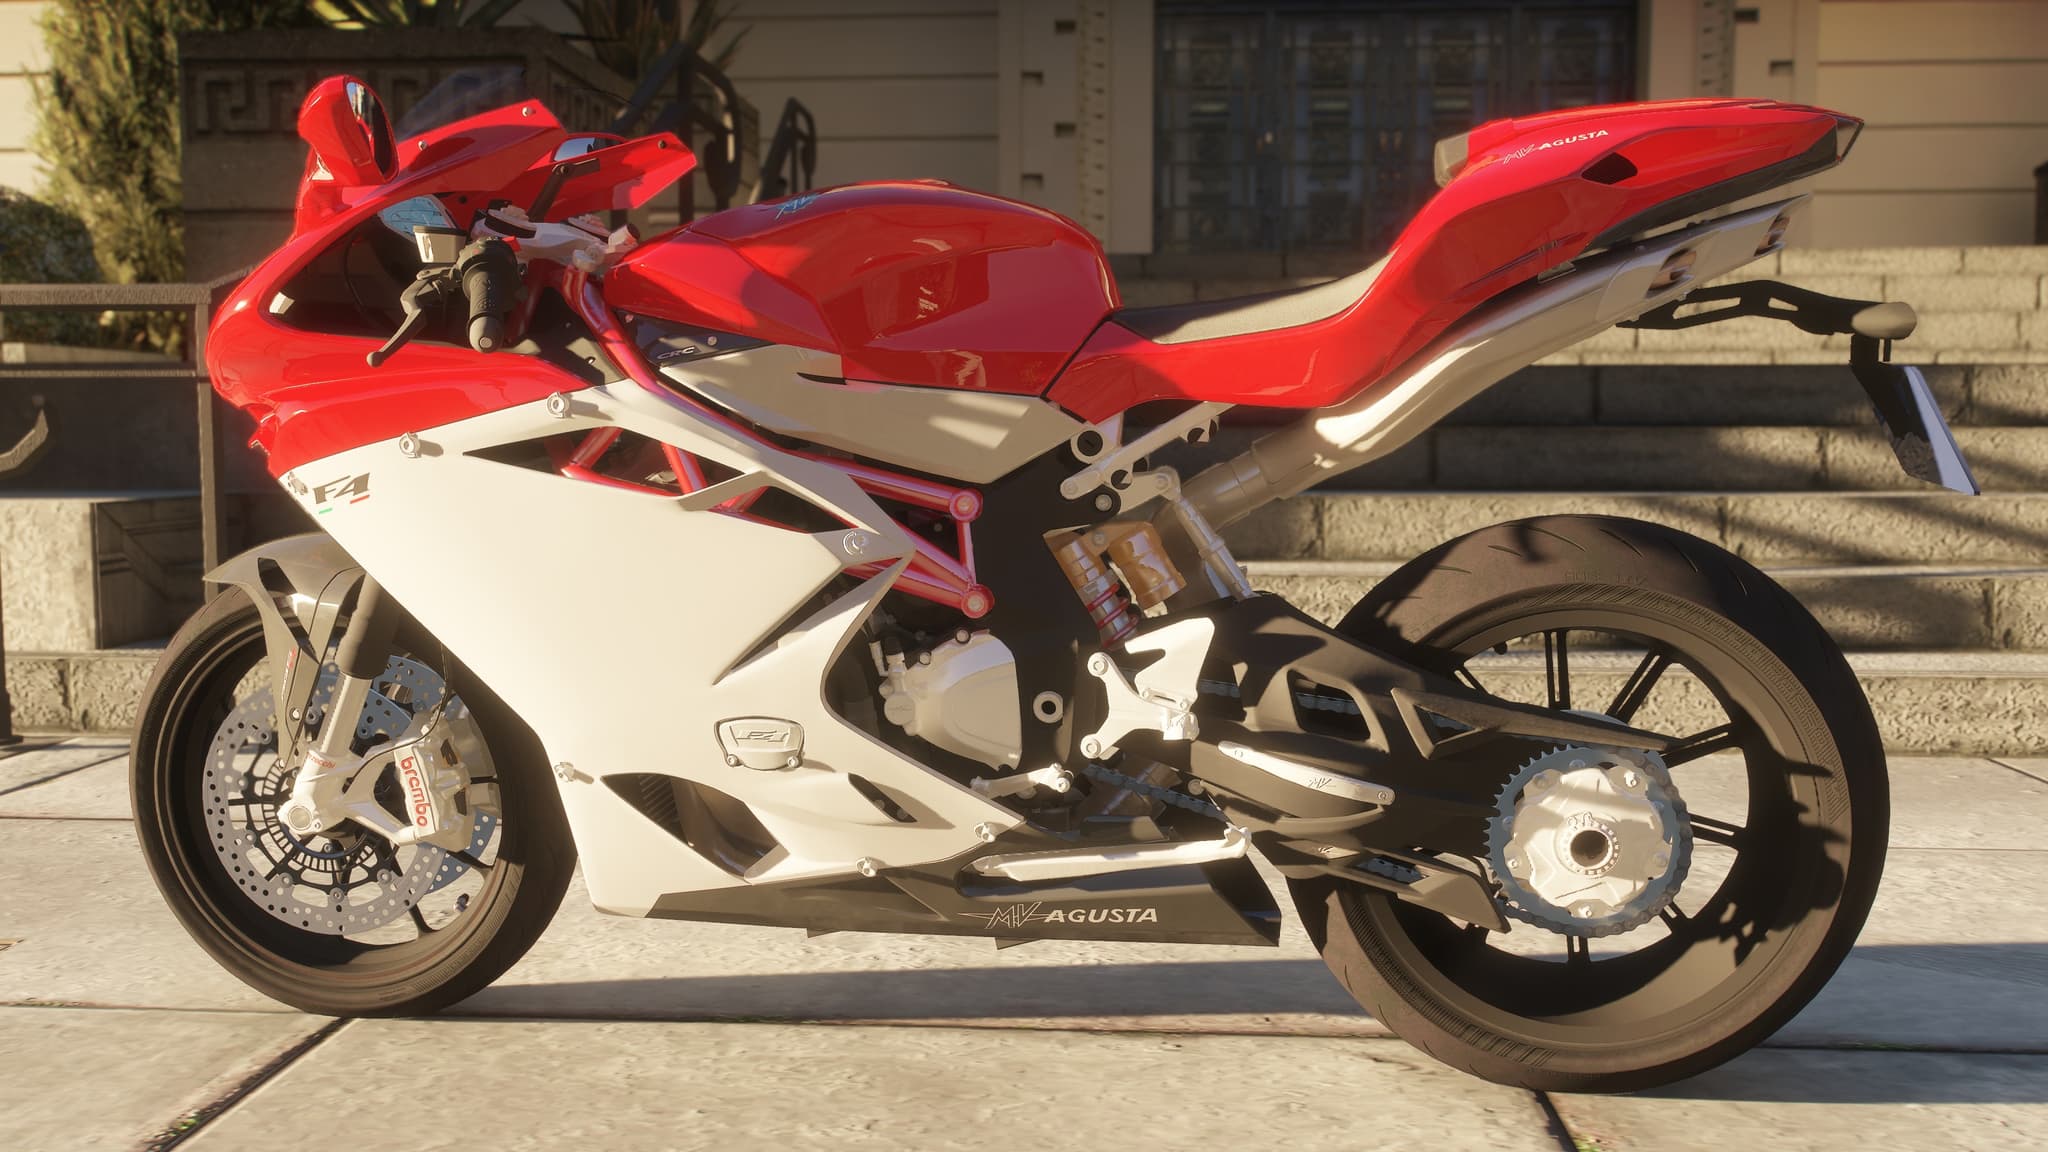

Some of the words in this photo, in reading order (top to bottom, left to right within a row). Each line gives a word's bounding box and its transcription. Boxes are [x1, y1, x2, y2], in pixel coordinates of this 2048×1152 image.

[1539, 129, 1609, 151] AGUSTA
[656, 346, 696, 360] CRC
[312, 472, 370, 505] F4
[400, 755, 432, 828] brembo
[983, 900, 1043, 930] MV
[1043, 907, 1159, 924] AGUSTA
